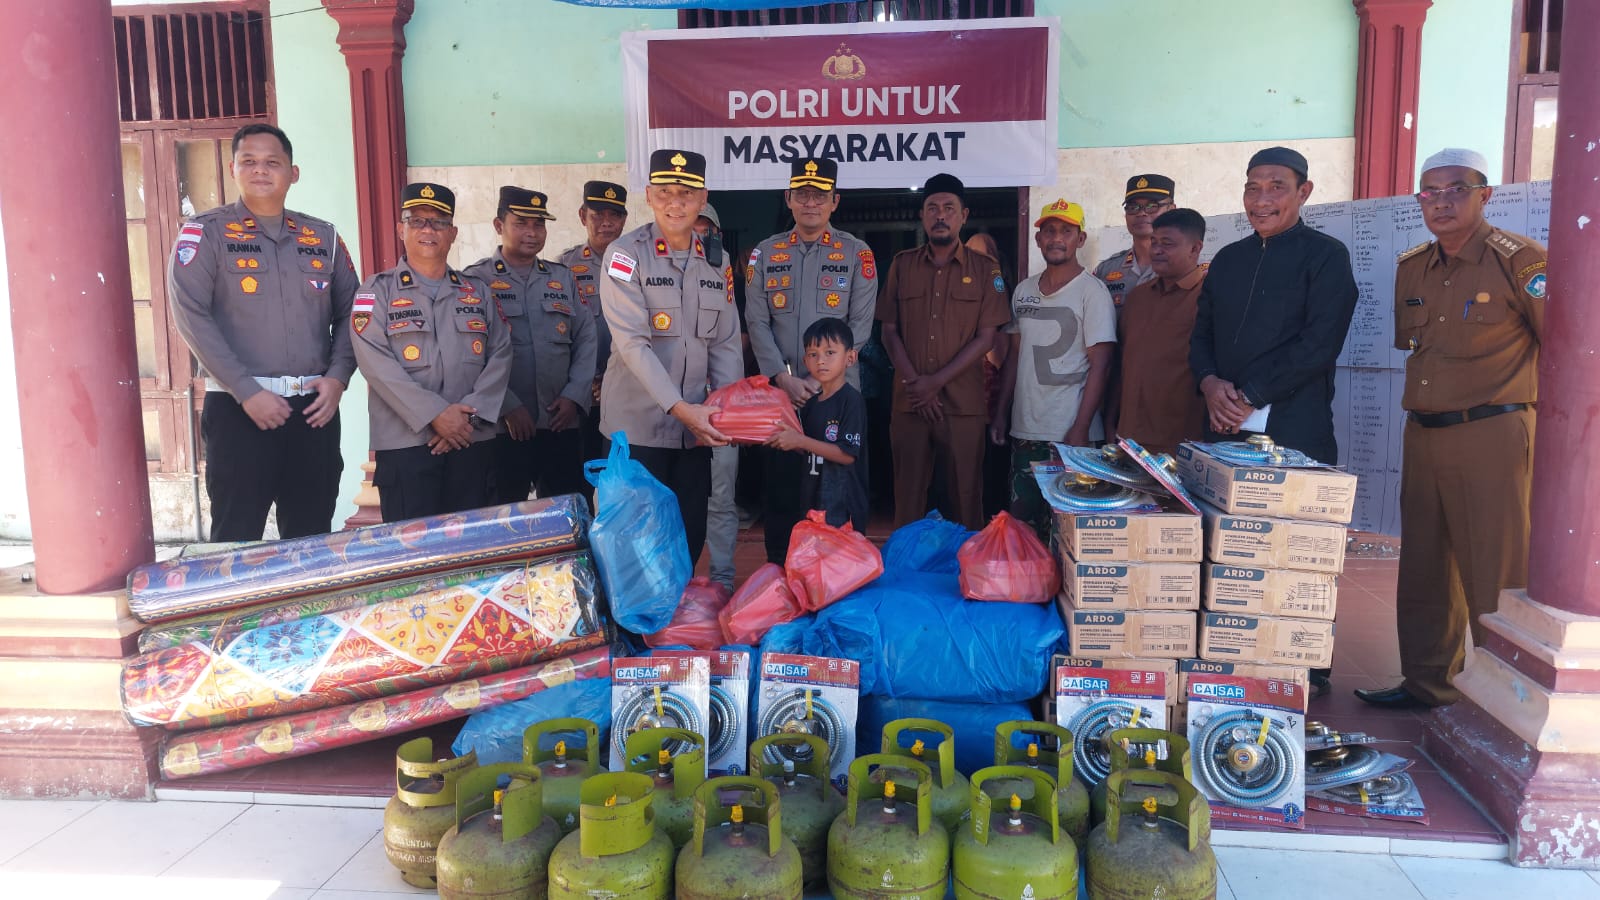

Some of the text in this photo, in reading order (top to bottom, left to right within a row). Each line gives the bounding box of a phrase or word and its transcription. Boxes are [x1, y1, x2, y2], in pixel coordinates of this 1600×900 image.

[728, 85, 961, 119] POLRI UNTUK
[723, 132, 965, 164] MASYARAKAT
[226, 244, 262, 253] IRAWAN
[298, 247, 328, 256] POLRI
[766, 264, 792, 273] RICKY
[822, 264, 848, 272] POLRI
[646, 277, 674, 287] ALDRO
[700, 280, 723, 290] POLRI
[544, 292, 568, 300] POLRI
[456, 307, 485, 316] POLRI
[1244, 472, 1275, 480] ARDO
[1231, 521, 1262, 530] ARDO
[1223, 569, 1254, 578] ARDO
[1216, 618, 1247, 626] ARDO
[766, 664, 808, 676] CAISAR
[1192, 663, 1222, 672] ARDO
[616, 668, 660, 678] CAISAR
[1062, 678, 1108, 690] CAISAR
[1194, 684, 1244, 698] CAISAR
[406, 840, 432, 848] UNTUK
